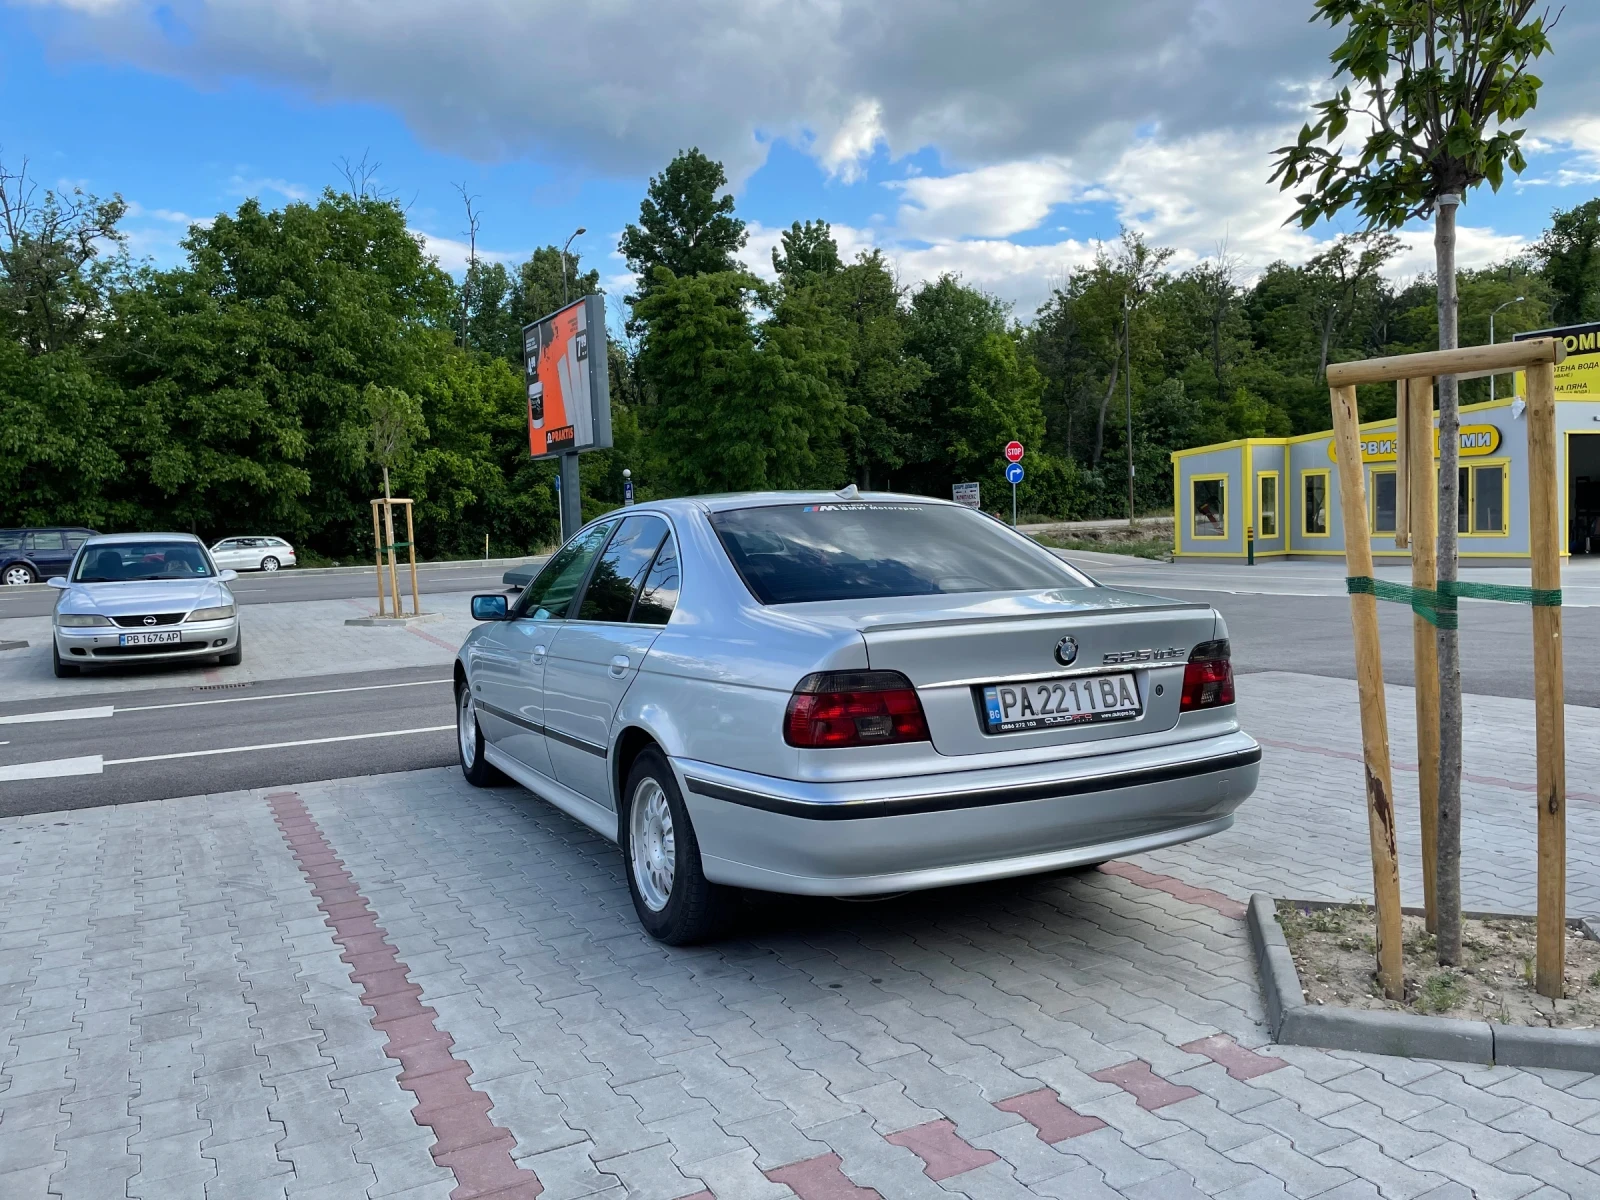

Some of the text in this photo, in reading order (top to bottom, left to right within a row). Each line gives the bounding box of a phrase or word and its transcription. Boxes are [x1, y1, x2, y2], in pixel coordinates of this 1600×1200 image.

[1553, 333, 1600, 352] ОМ
[1578, 362, 1599, 370] ВОДА
[1566, 382, 1588, 390] ПЯНА
[552, 427, 573, 442] PRAKTIS
[1007, 448, 1021, 456] STOP
[126, 635, 140, 644] PB
[142, 633, 164, 643] 1676
[166, 633, 179, 642] AP
[989, 710, 1000, 719] BG
